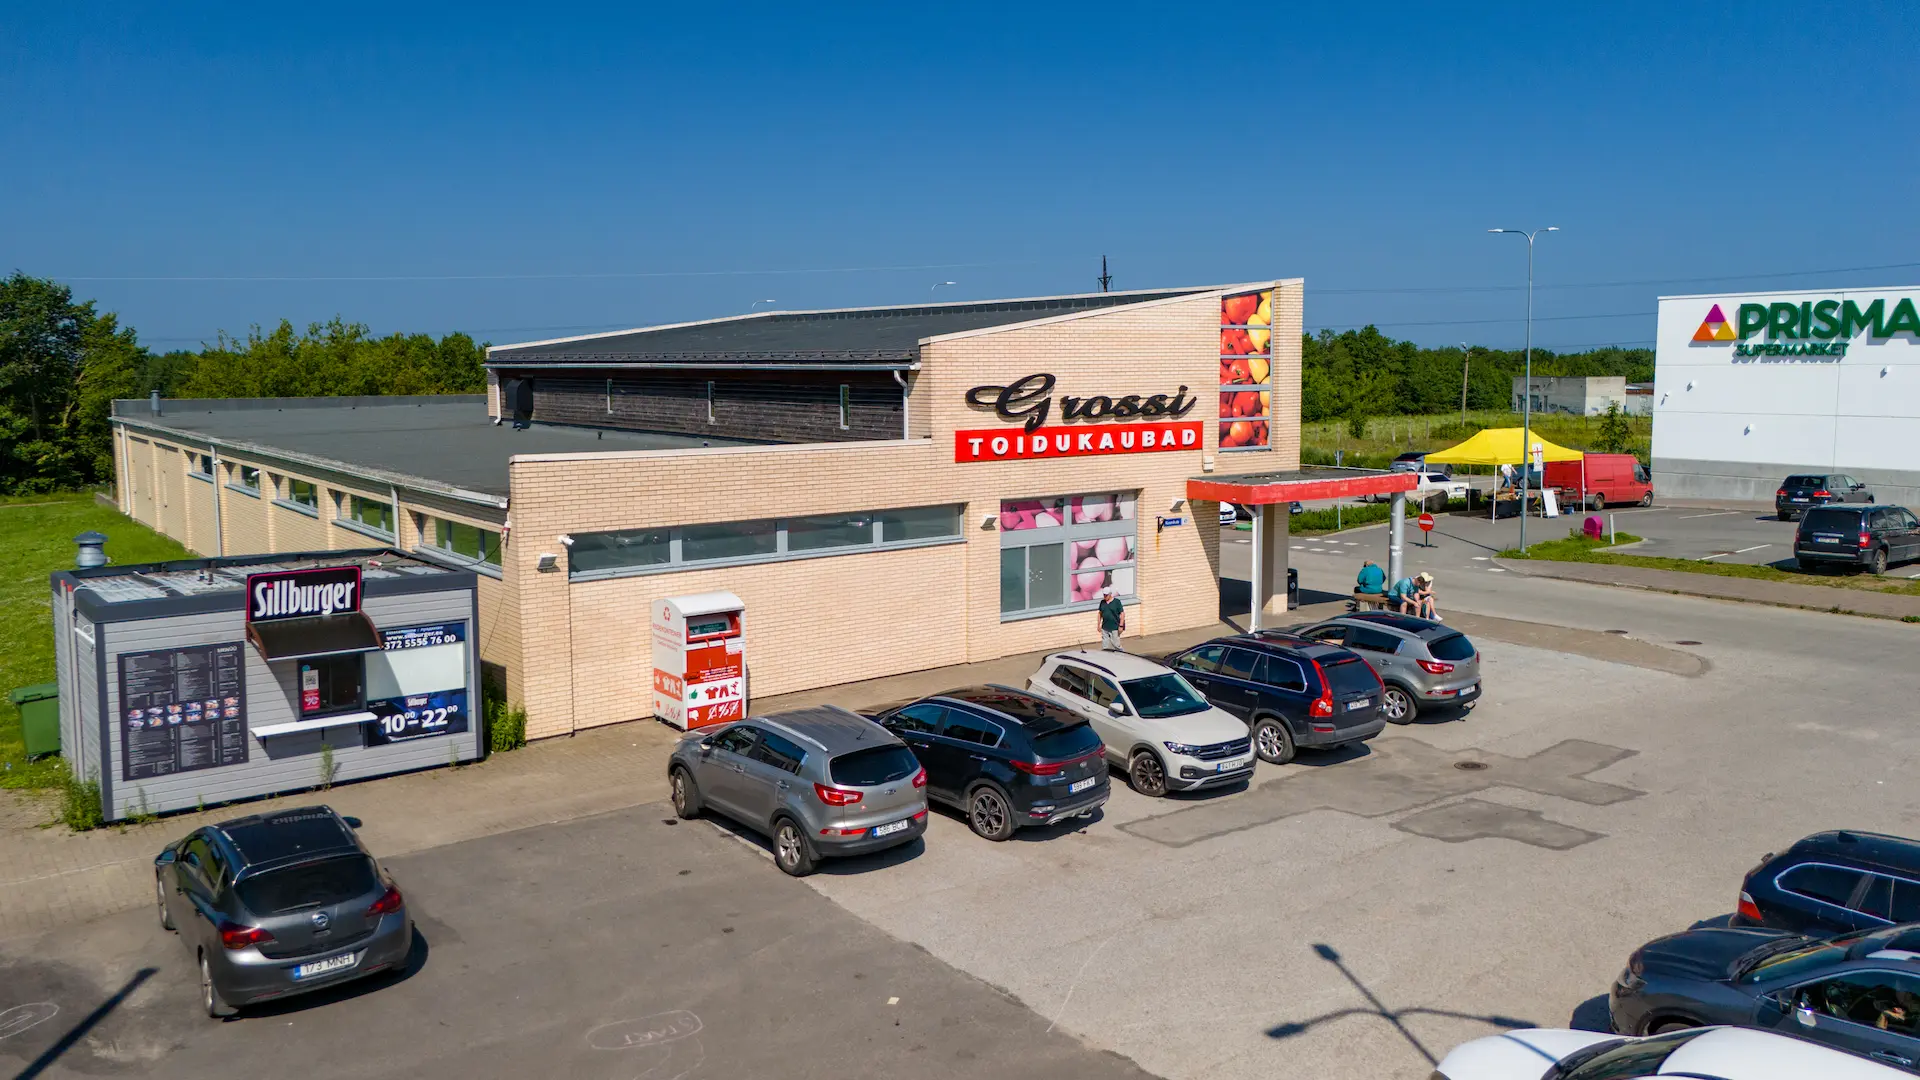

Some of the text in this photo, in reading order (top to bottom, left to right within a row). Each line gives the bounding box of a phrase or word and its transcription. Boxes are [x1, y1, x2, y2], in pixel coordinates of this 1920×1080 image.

[1738, 298, 1920, 340] PRISMA
[1736, 343, 1849, 357] SUPERMARKET
[965, 373, 1197, 433] Grossi
[968, 428, 1197, 457] TOIDUKAUBAD
[254, 580, 356, 617] Sillburger
[431, 636, 443, 645] 76
[444, 634, 456, 643] 00
[305, 954, 351, 973] 173 MNH
